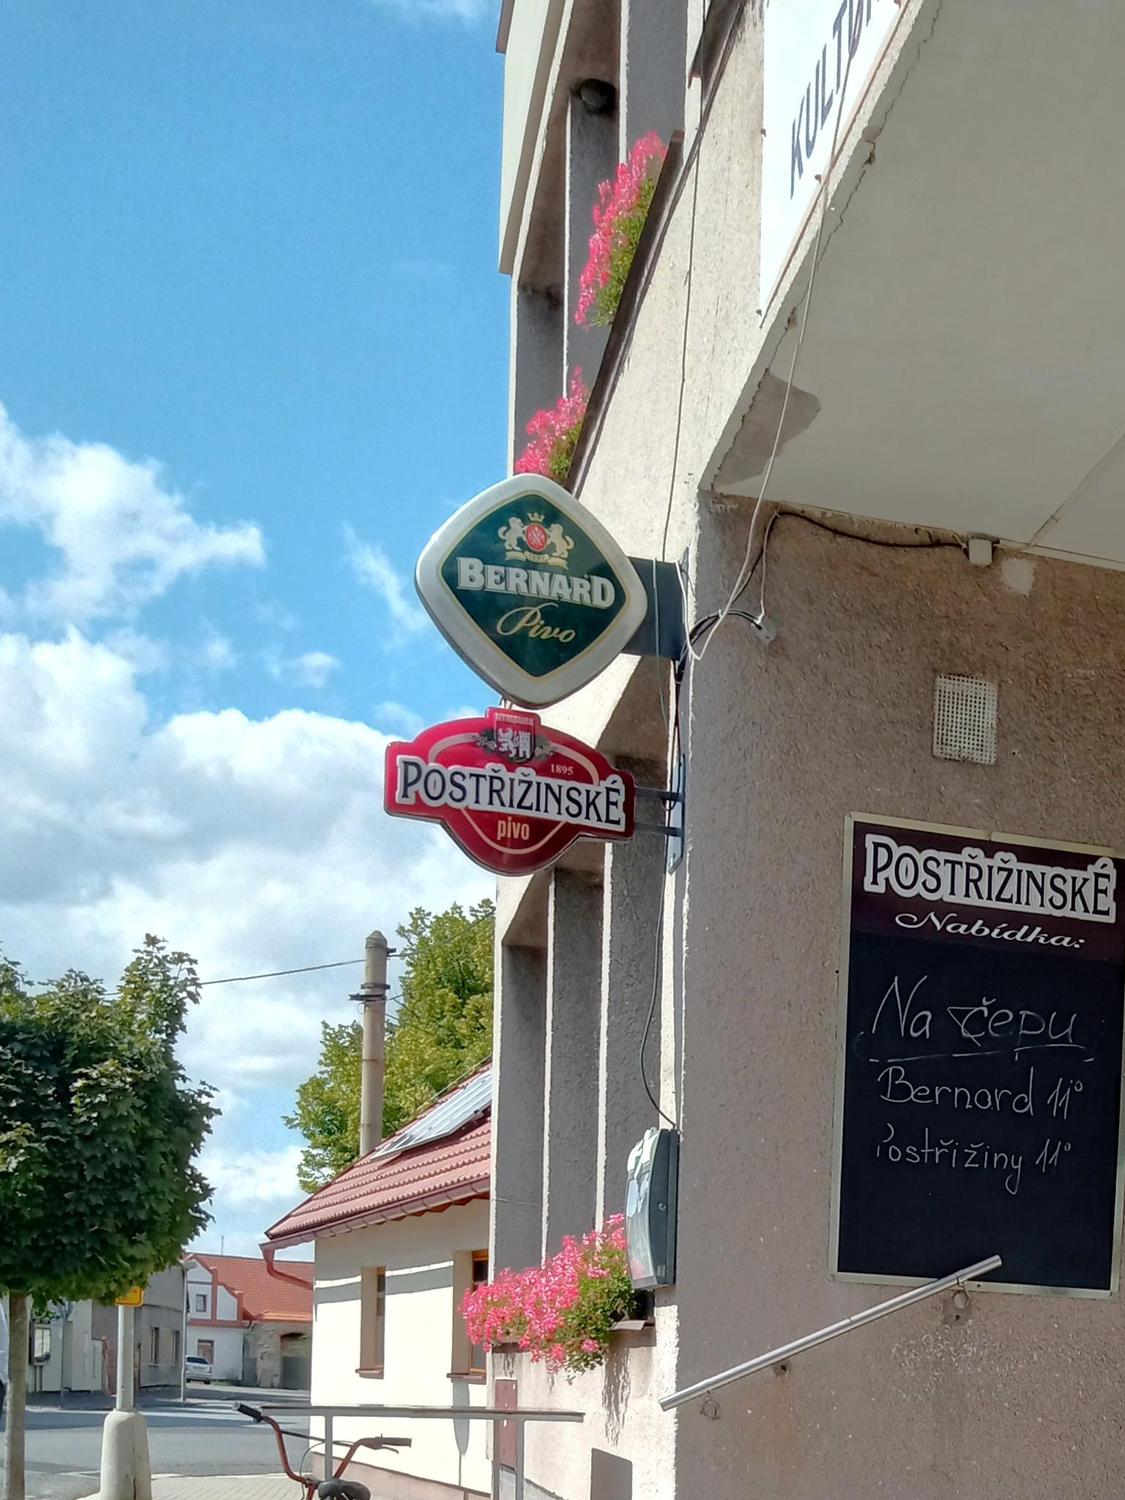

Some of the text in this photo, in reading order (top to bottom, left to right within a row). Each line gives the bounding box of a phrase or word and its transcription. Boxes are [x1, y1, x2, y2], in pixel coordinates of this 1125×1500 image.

[790, 0, 872, 200] KULTU
[457, 556, 616, 610] BERNARD
[496, 602, 577, 643] Pivo
[401, 760, 622, 826] POSTŘIŽINSKÉ
[550, 763, 574, 776] 1895
[497, 816, 530, 841] pivo
[870, 840, 1112, 917] POSTŘIŽINSKÉ
[895, 910, 1087, 949] Nabídka:
[871, 975, 932, 1039] Na
